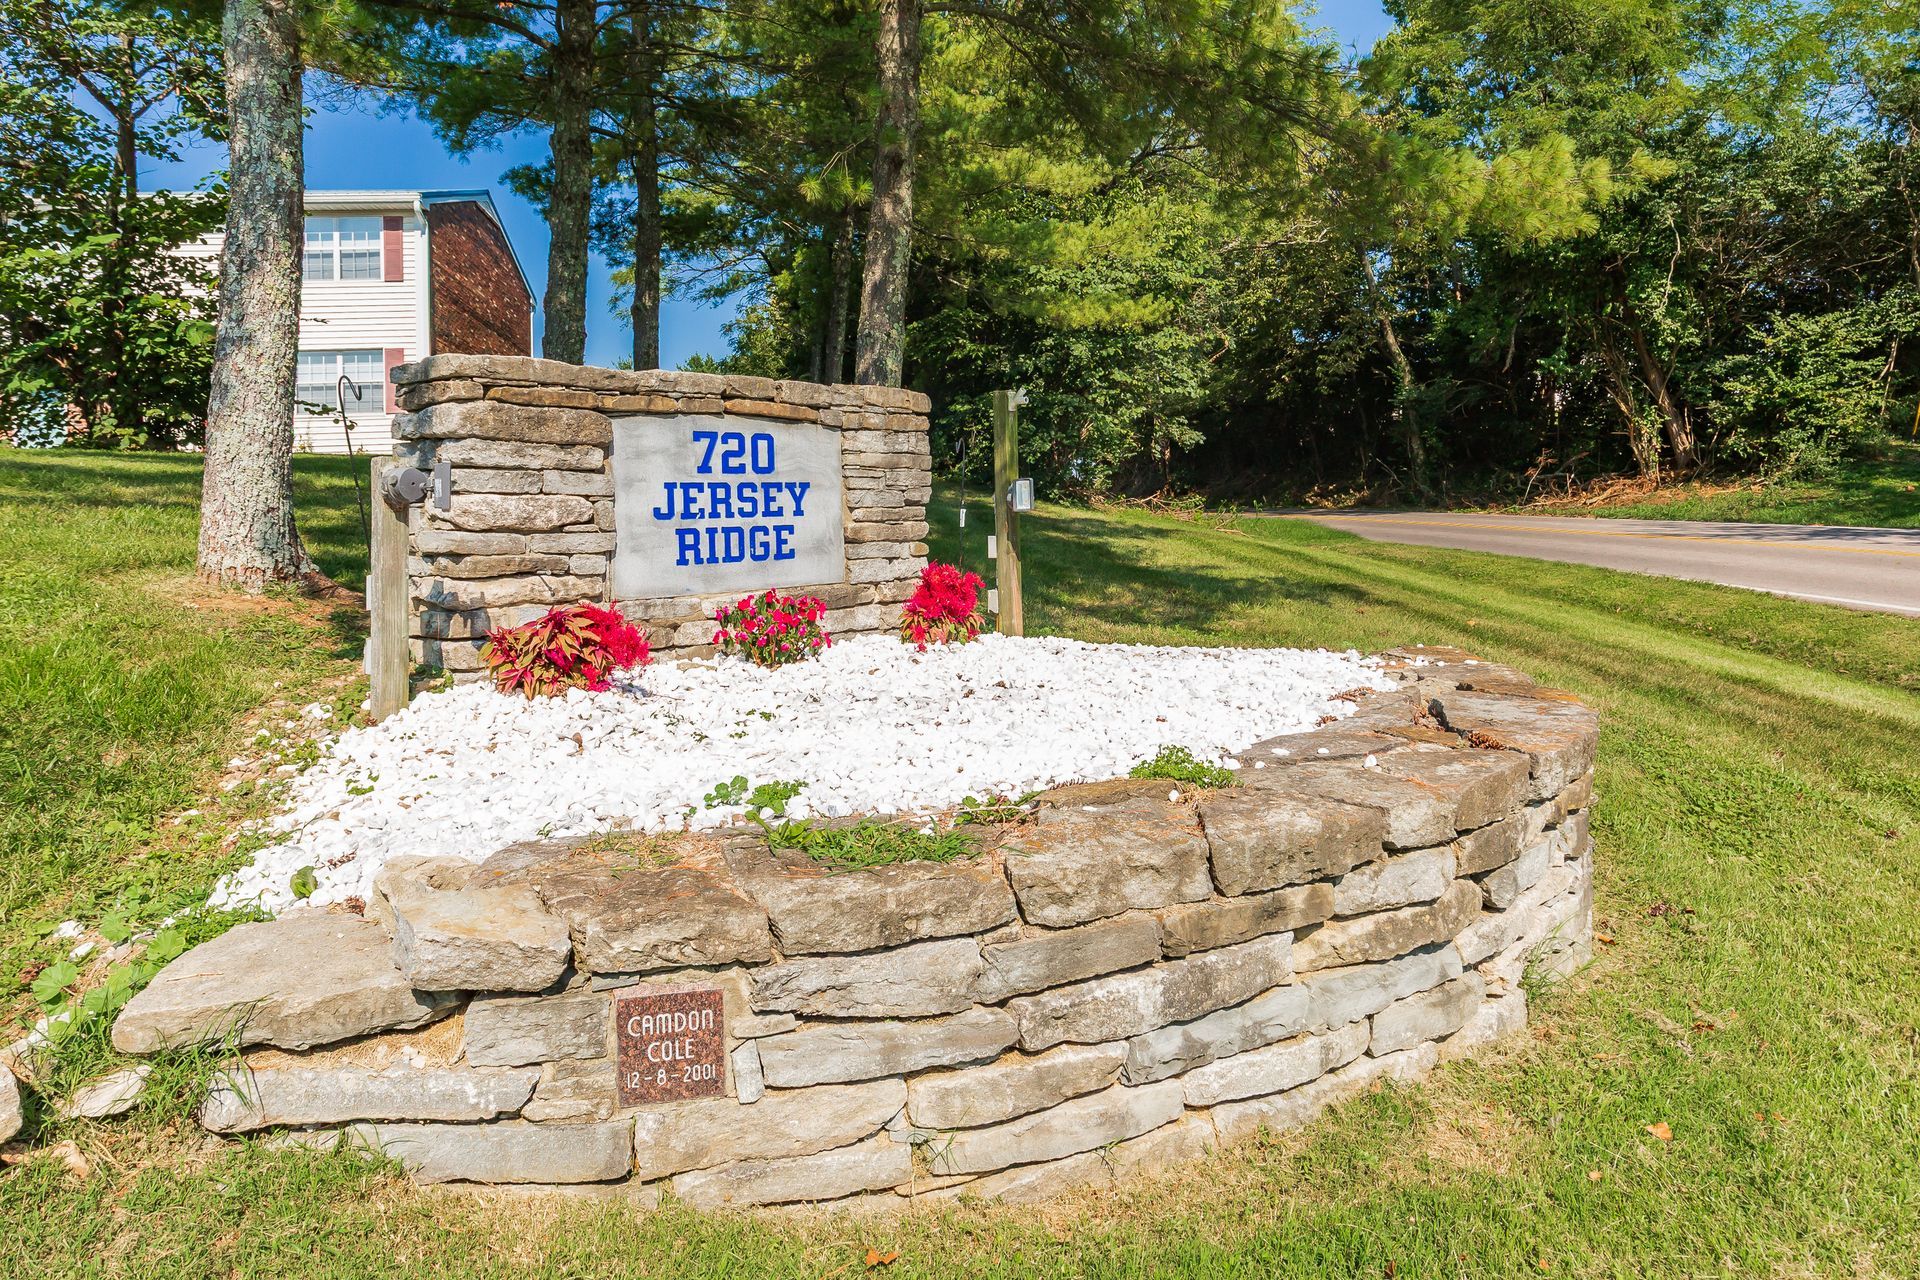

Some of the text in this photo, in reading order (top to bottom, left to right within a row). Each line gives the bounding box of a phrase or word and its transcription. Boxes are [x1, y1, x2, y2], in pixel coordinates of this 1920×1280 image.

[692, 431, 775, 474] 720
[653, 482, 811, 520] JERSEY
[675, 525, 796, 566] RIDGE
[627, 1009, 714, 1037] CAMDON
[647, 1039, 695, 1062] COLE
